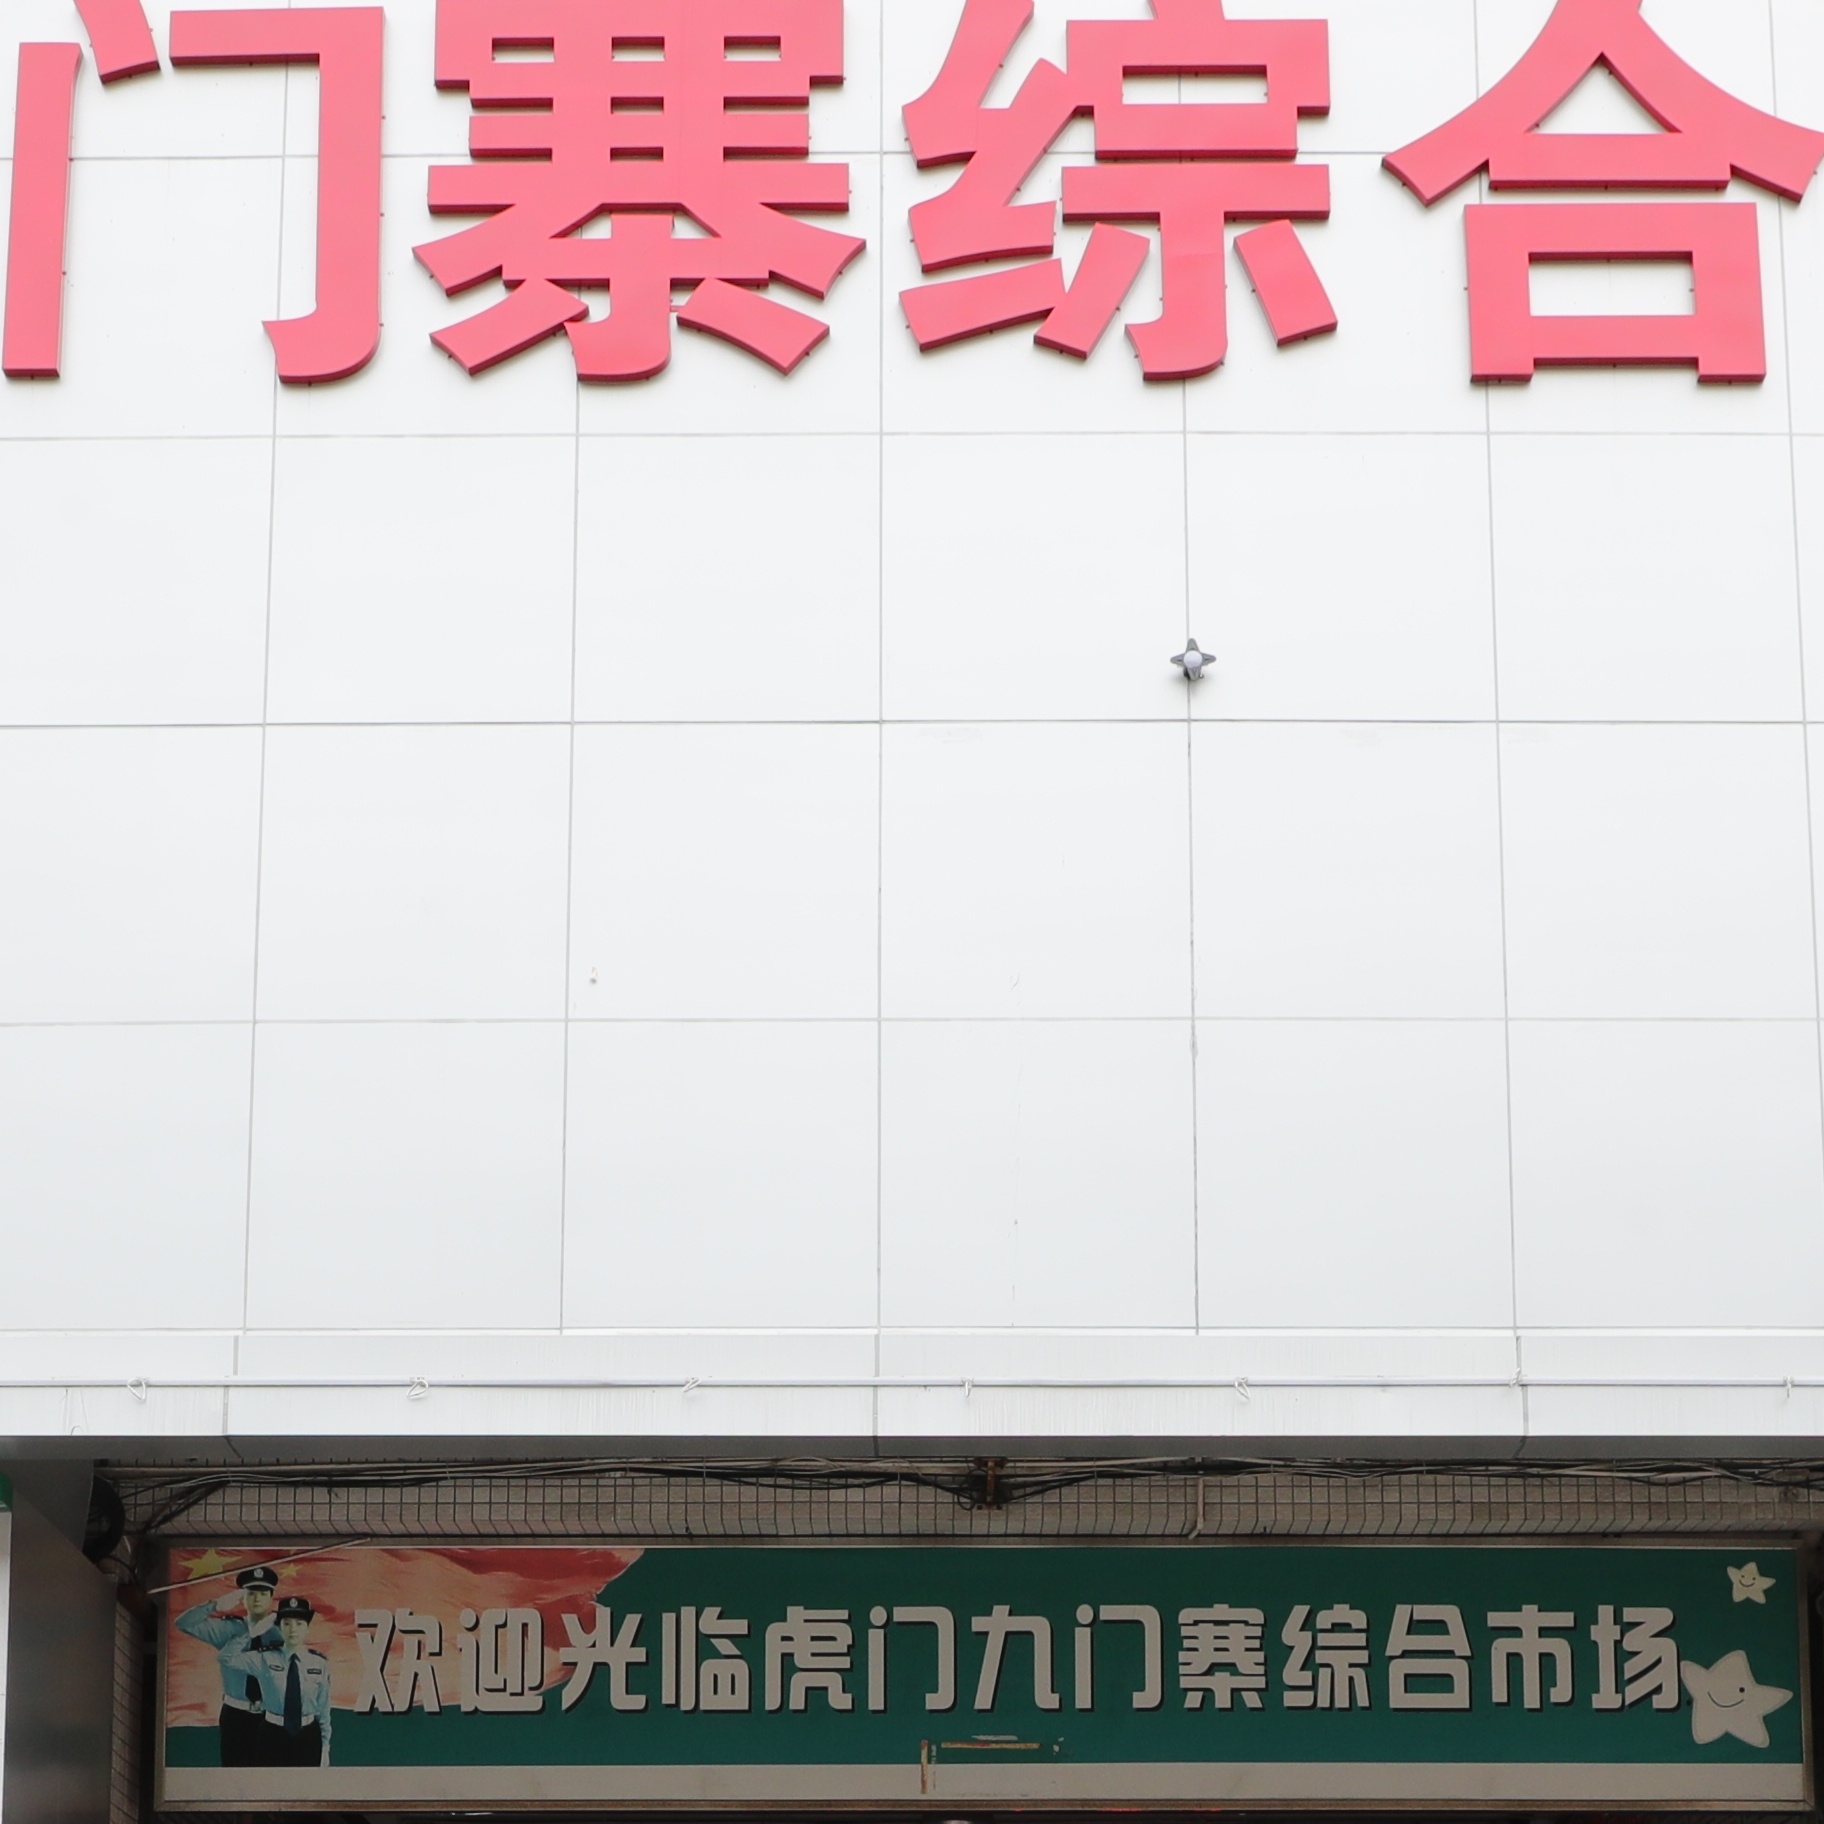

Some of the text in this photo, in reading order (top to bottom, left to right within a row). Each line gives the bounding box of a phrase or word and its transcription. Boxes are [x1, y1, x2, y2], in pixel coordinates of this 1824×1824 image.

[352, 1602, 1683, 1717] 欢迎光临虎门九门寨综合市场
